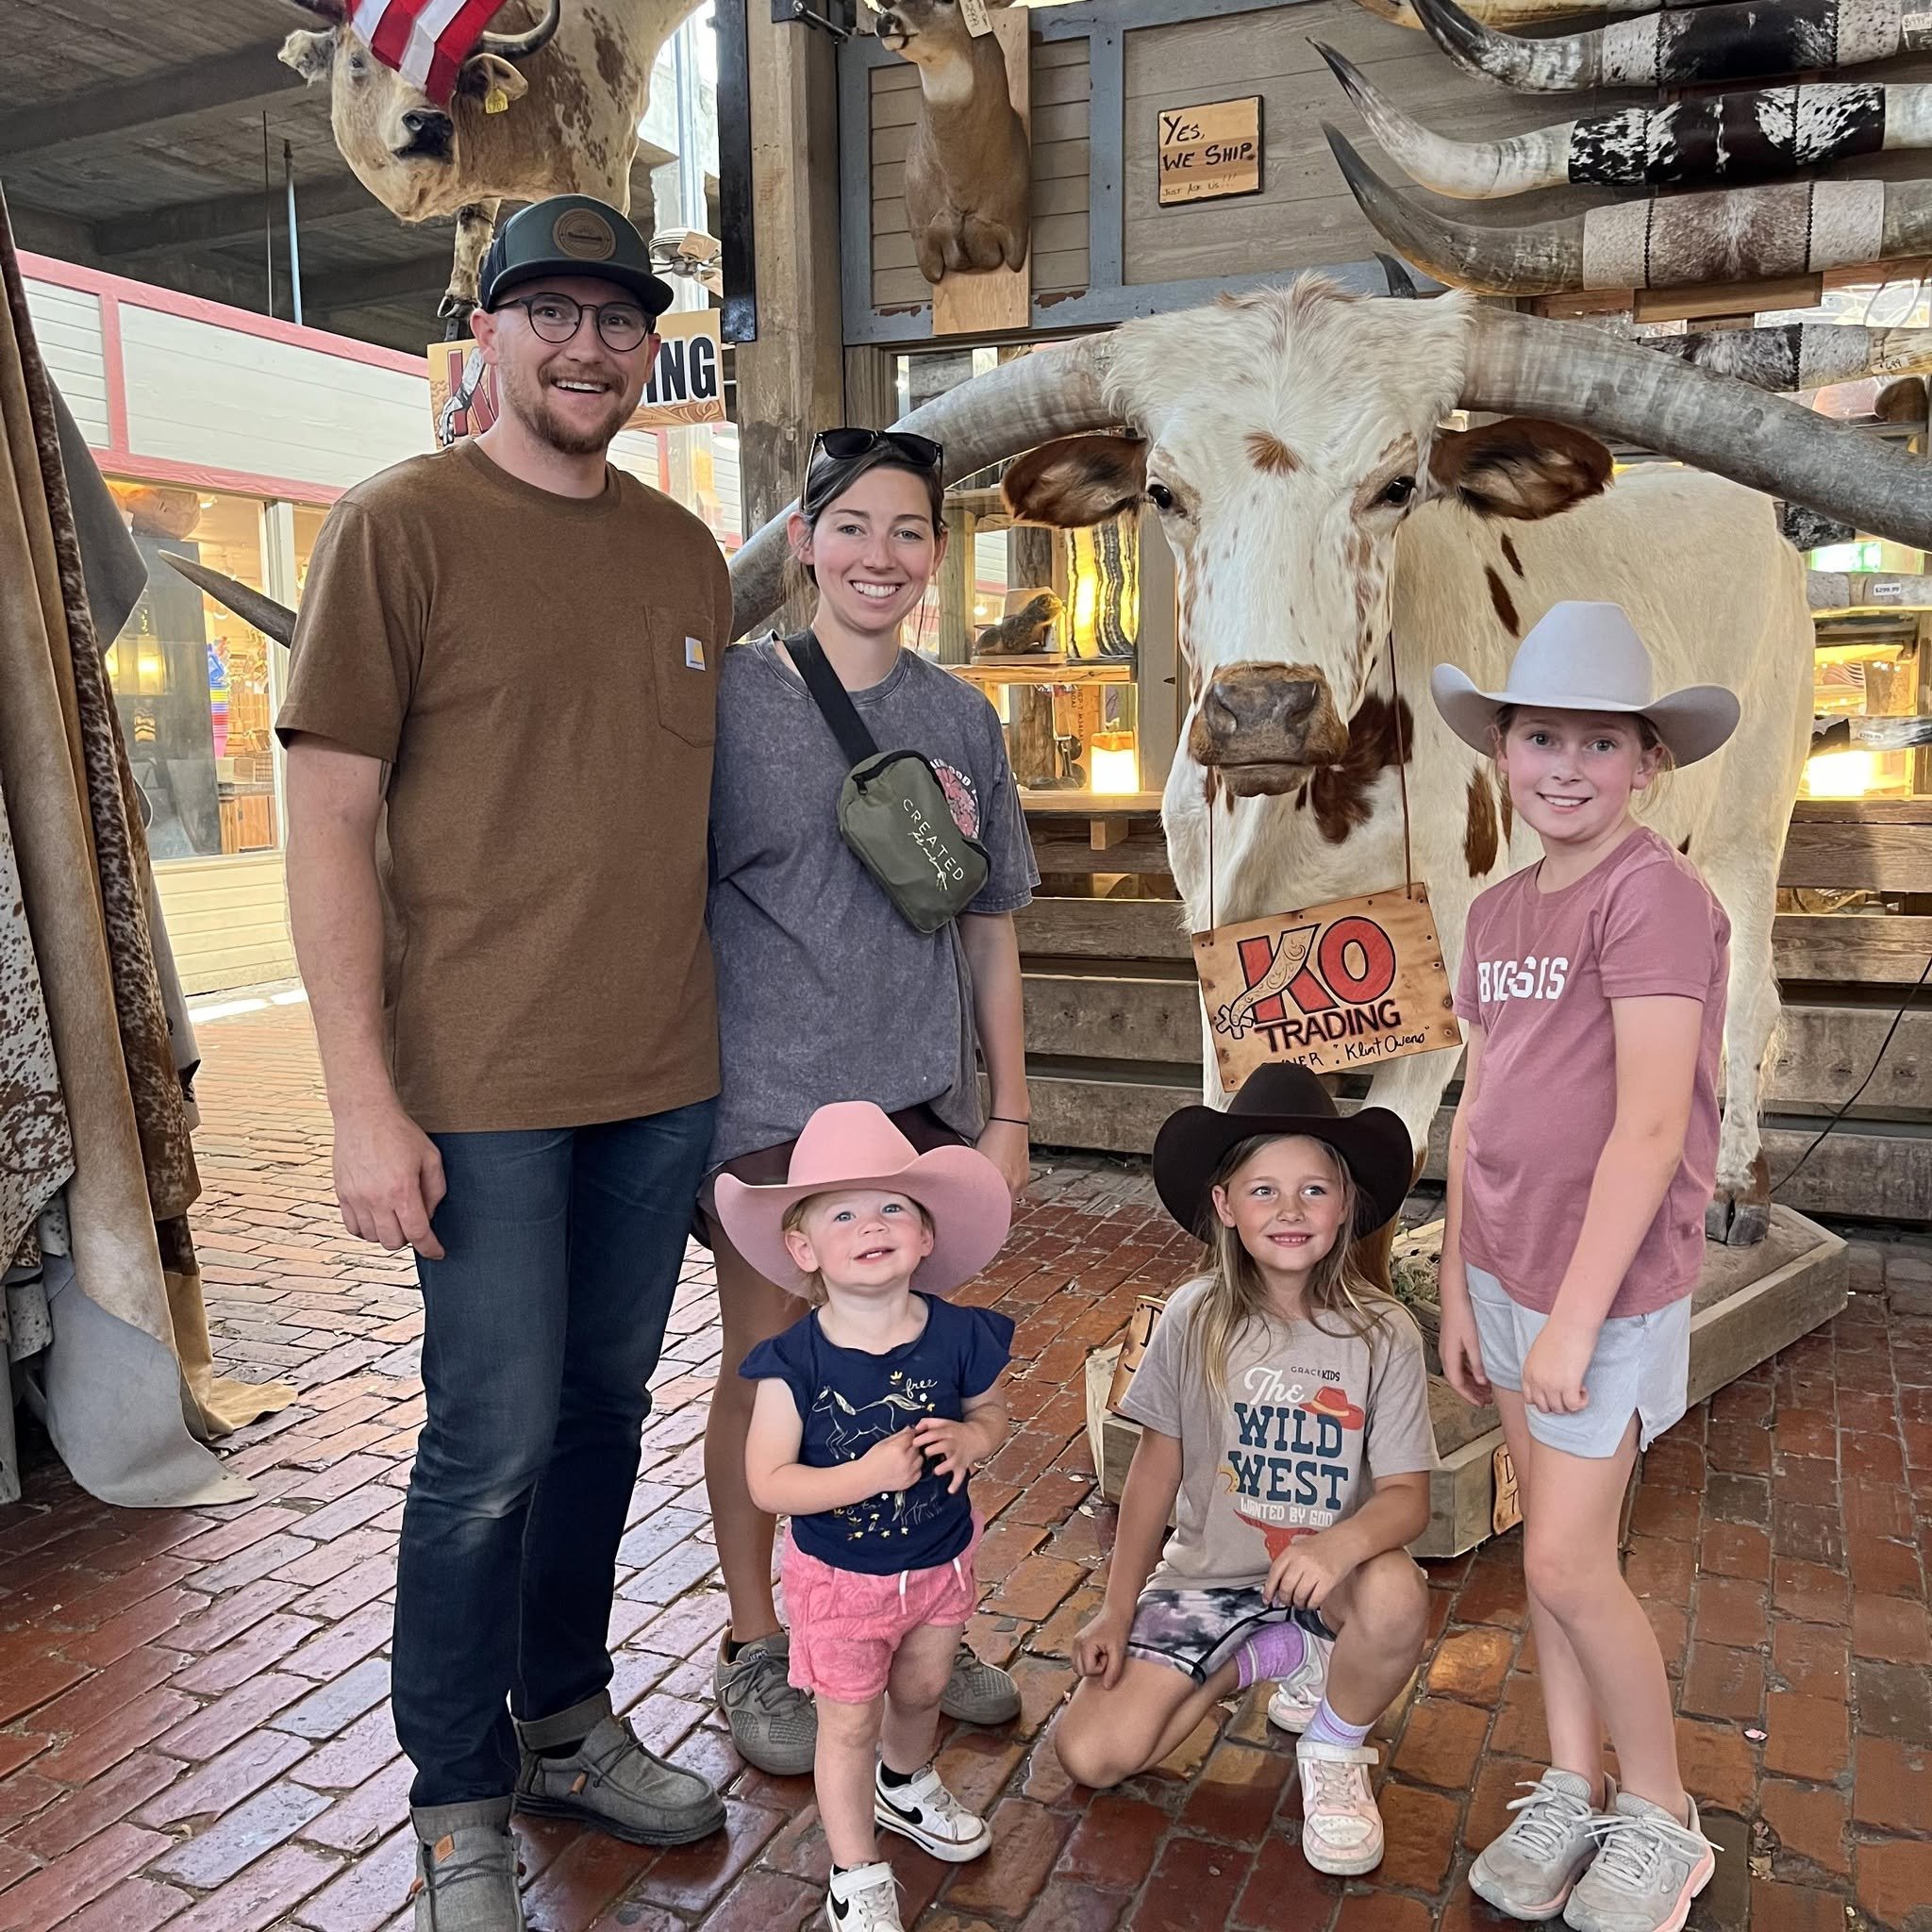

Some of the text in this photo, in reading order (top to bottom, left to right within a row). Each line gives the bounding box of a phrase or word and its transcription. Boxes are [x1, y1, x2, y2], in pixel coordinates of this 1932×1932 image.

[1162, 152, 1195, 172] WE
[903, 798, 964, 881] CREATED
[1231, 915, 1396, 1024] KO
[1511, 956, 1568, 999] SIS
[1254, 998, 1402, 1053] TRADING
[902, 1378, 938, 1399] free
[1243, 1367, 1306, 1406] The
[1234, 1403, 1342, 1458] WILD
[1228, 1451, 1349, 1510] WEST
[1241, 1497, 1334, 1527] WANTED BY GOD
